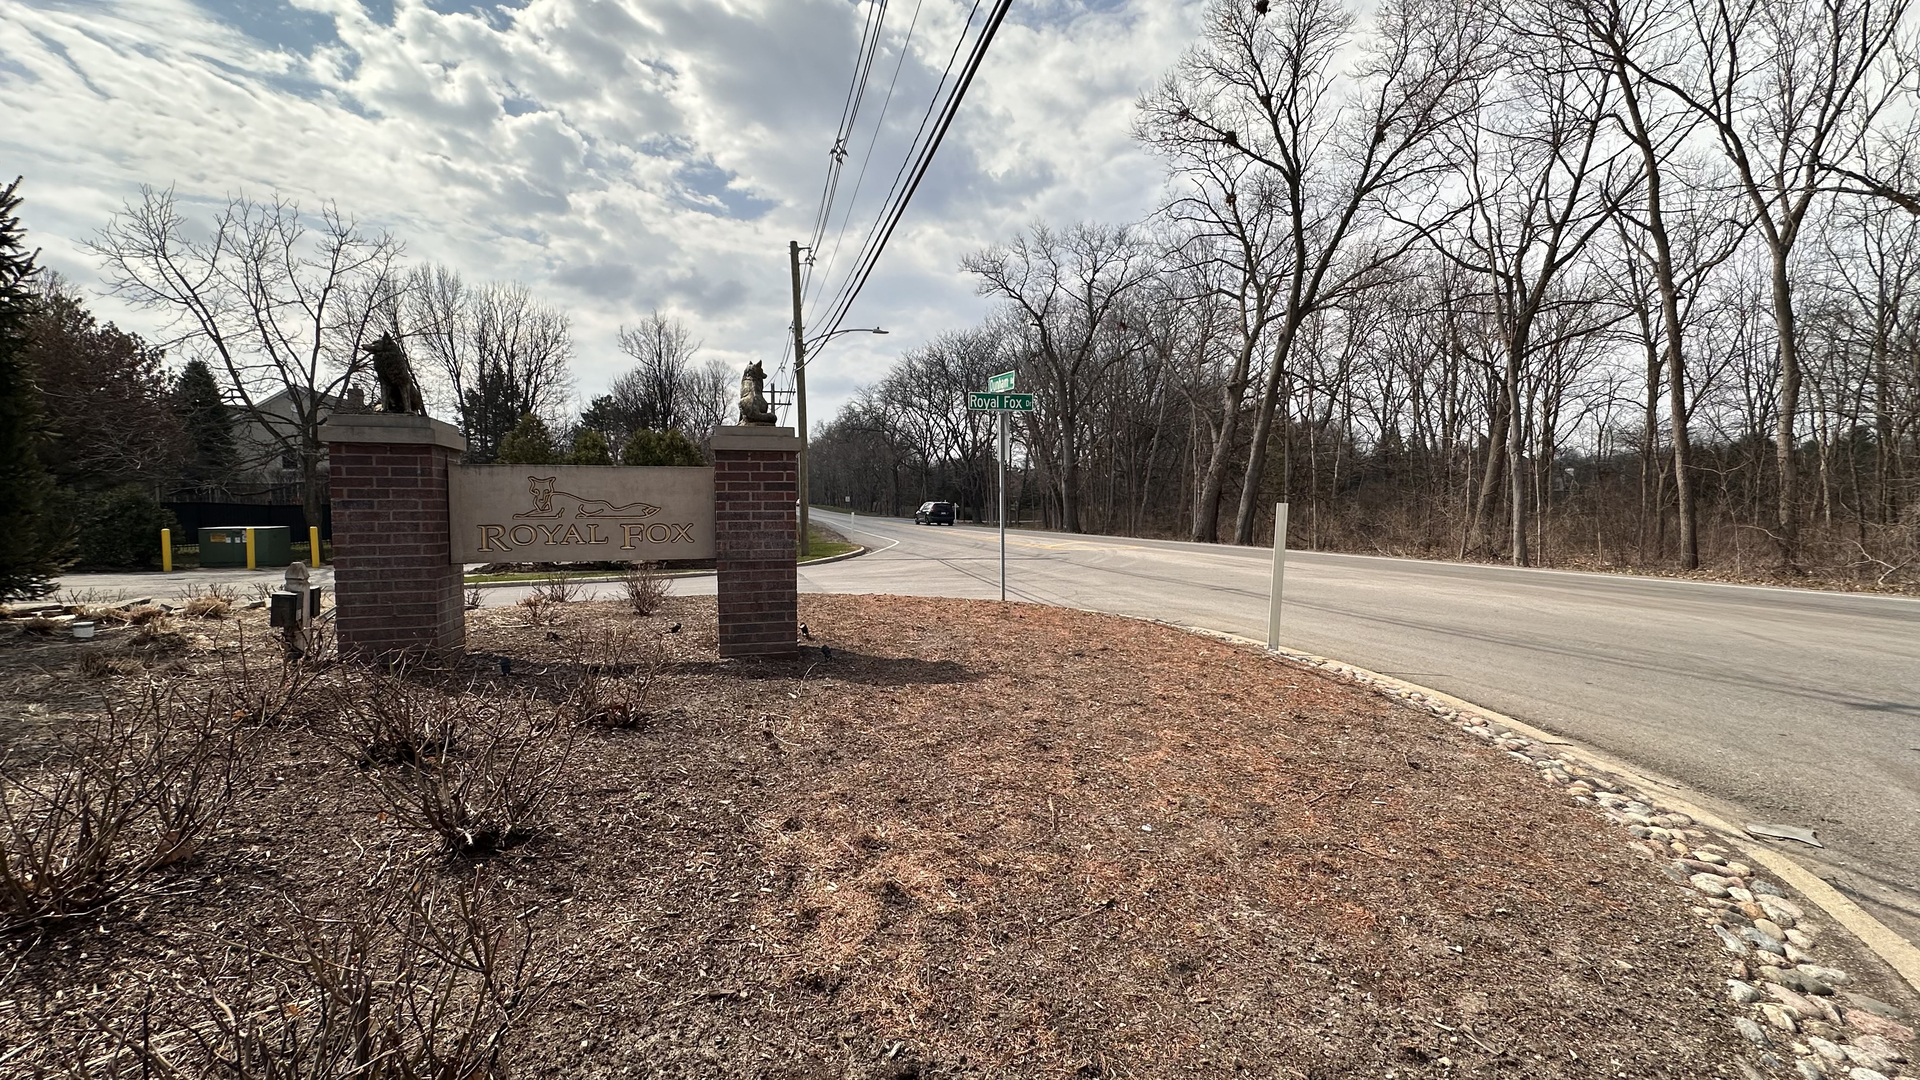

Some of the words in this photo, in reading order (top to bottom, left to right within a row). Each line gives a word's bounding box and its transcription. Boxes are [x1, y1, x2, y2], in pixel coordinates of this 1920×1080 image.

[970, 394, 999, 409] Royal
[1004, 395, 1022, 409] Fox
[477, 523, 609, 552] ROYAL
[620, 522, 695, 550] FOX
